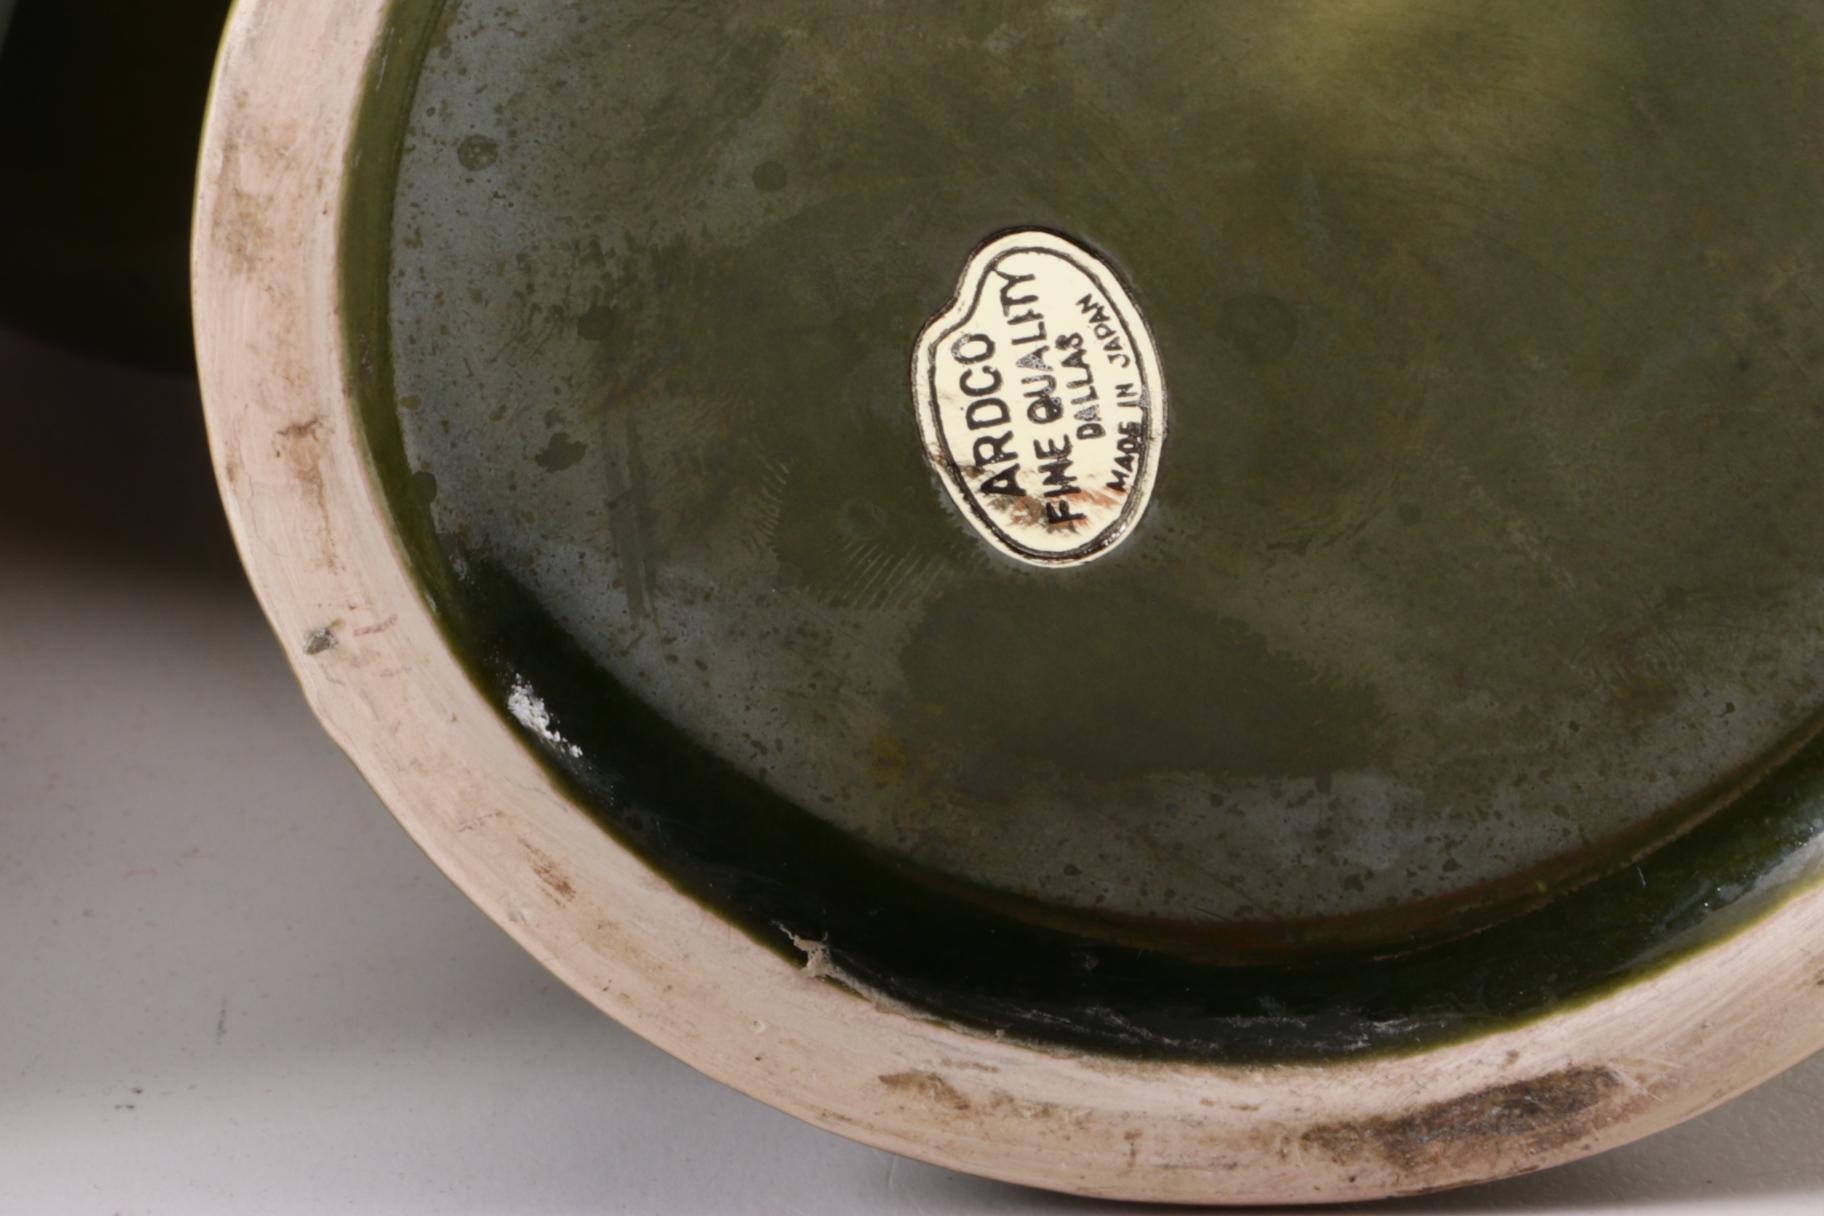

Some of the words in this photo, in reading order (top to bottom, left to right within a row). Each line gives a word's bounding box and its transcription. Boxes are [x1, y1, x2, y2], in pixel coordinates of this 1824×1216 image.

[994, 270, 1064, 424] QUALITY
[1076, 294, 1131, 369] JAPAN
[951, 333, 1026, 497] ARDCO
[1055, 333, 1107, 440] DALLAS
[1115, 383, 1139, 408] IN
[1033, 433, 1088, 524] FINE
[1106, 421, 1142, 493] MADE
